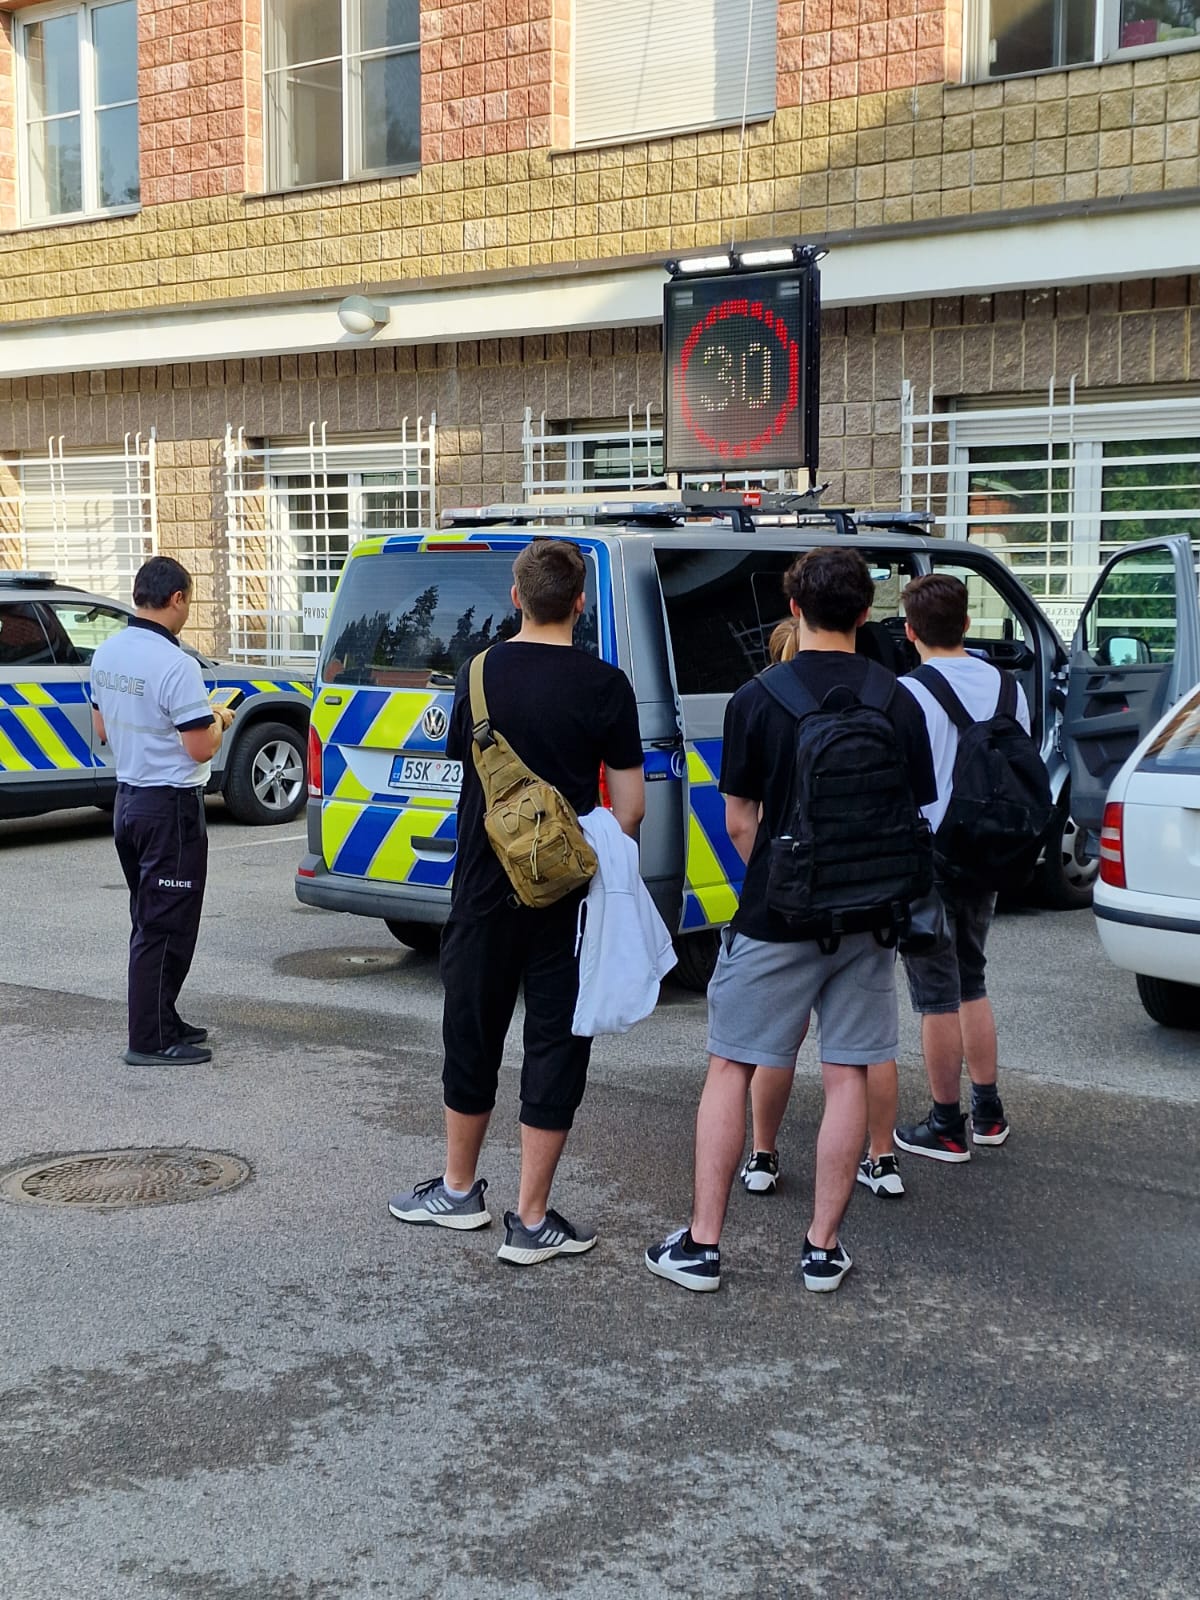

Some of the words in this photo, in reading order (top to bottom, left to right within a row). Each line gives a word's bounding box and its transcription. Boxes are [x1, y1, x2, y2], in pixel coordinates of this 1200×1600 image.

[700, 342, 772, 411] 30
[405, 761, 432, 782] 5SK
[441, 763, 461, 783] 23
[158, 878, 192, 889] POLICIE
